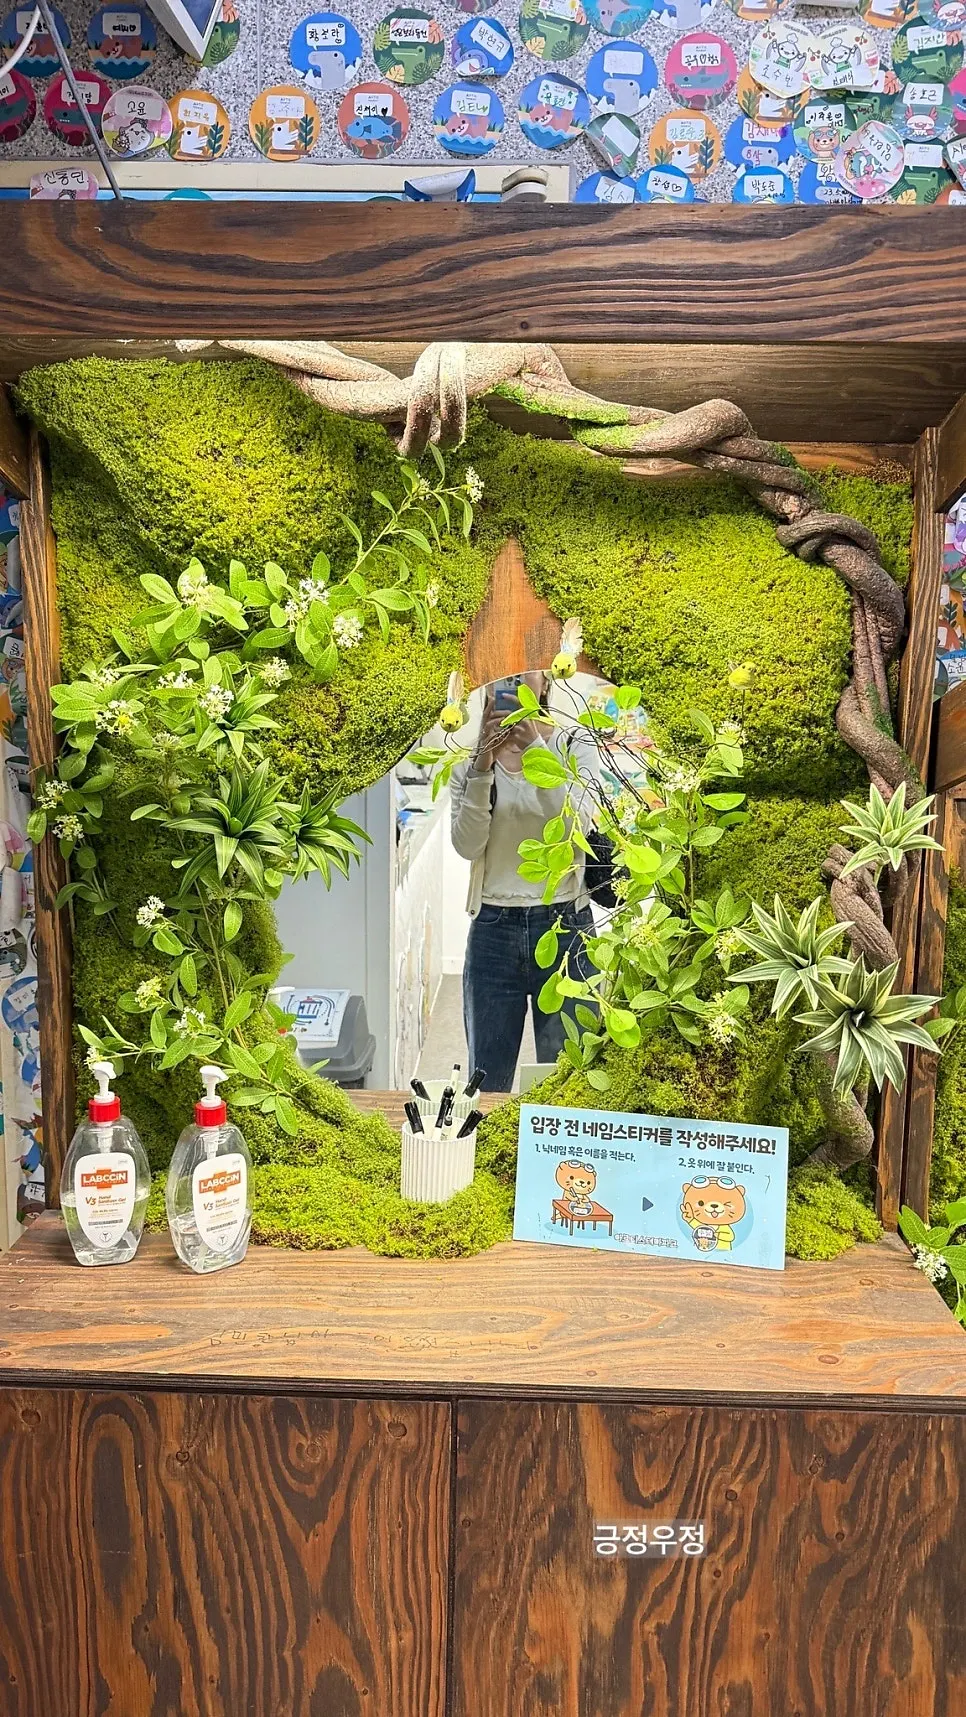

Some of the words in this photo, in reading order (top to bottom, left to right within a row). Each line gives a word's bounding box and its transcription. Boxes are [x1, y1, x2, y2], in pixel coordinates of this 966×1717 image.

[530, 1116, 561, 1136] 입장
[563, 1119, 579, 1138] 전
[583, 1121, 674, 1147] 네임스티커를
[676, 1129, 777, 1155] 작성해주세요!
[542, 1144, 567, 1156] 닉네임
[567, 1147, 583, 1158] 혹은
[584, 1148, 608, 1160] 이름을
[609, 1150, 636, 1162] 적는다.
[687, 1158, 696, 1170] 옷
[696, 1159, 715, 1170] 위에
[716, 1160, 726, 1172] 잘
[727, 1161, 755, 1174] 붙인다.
